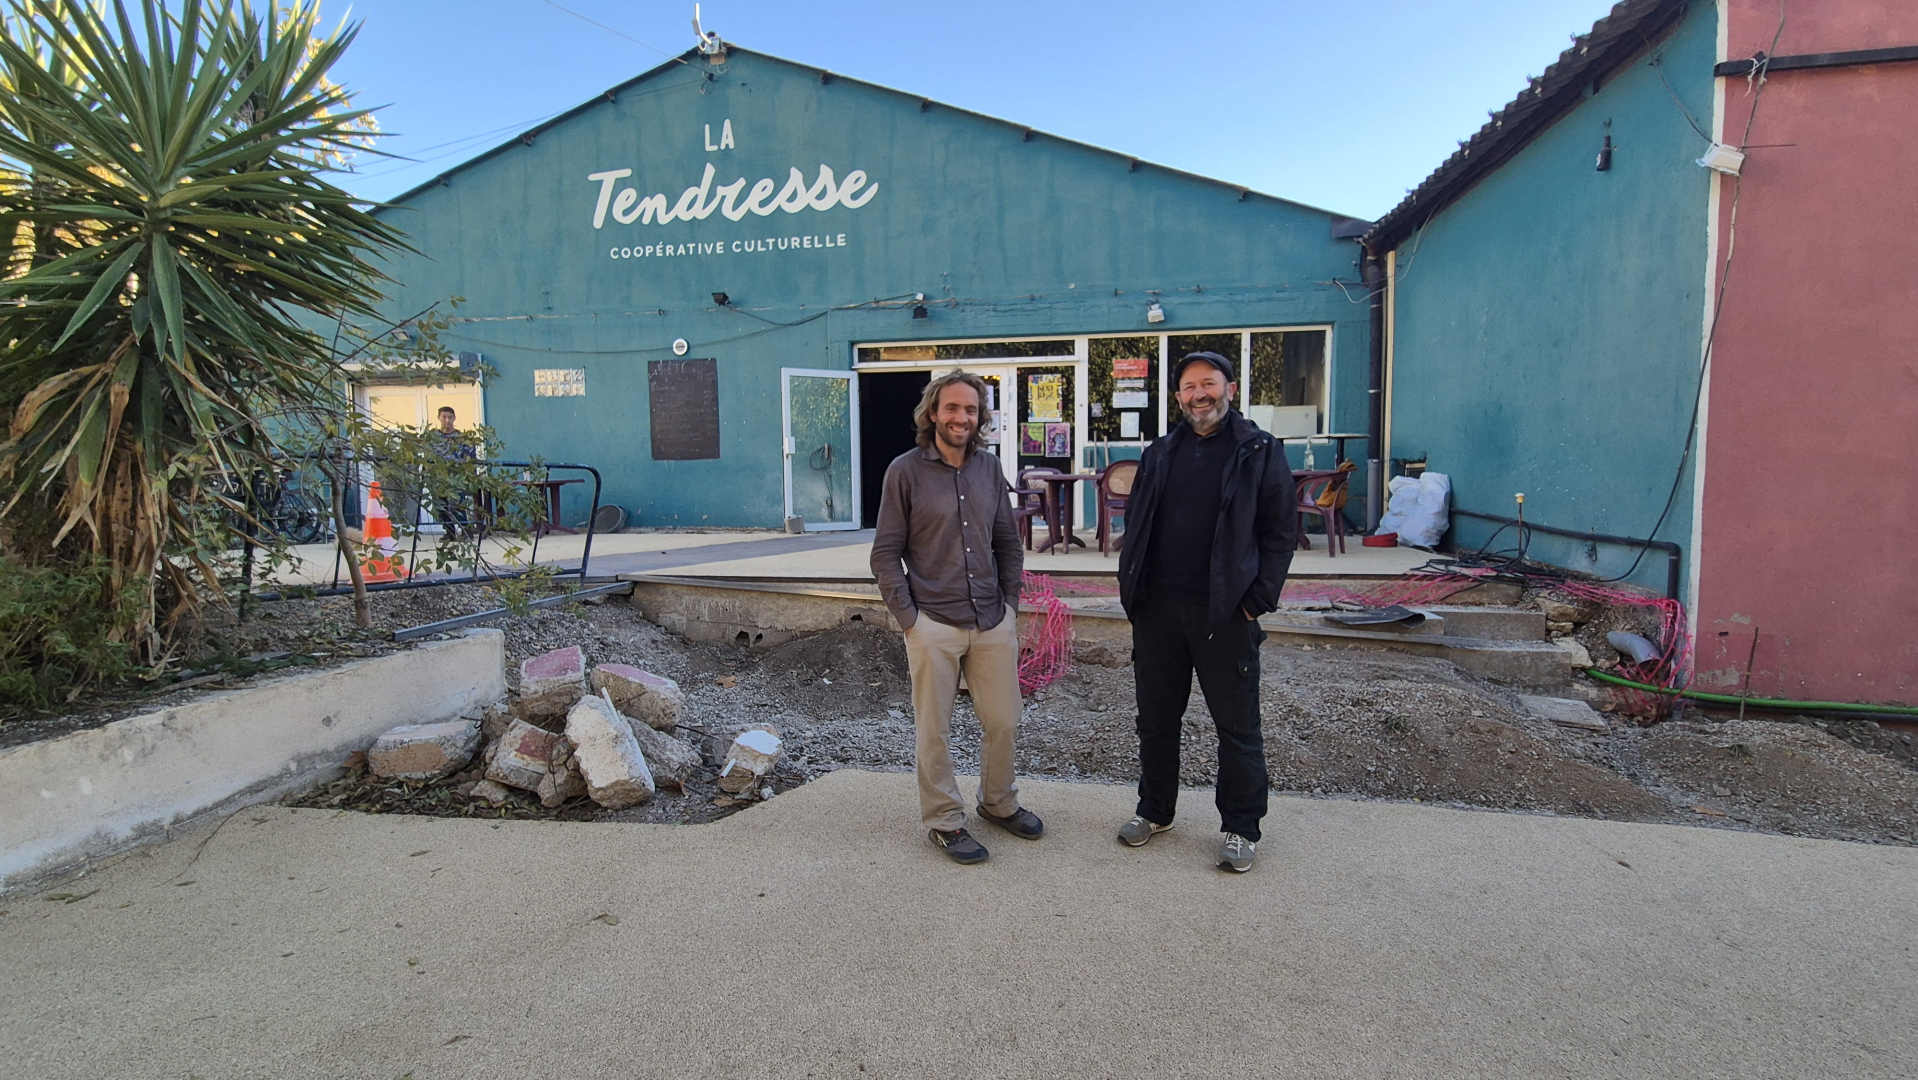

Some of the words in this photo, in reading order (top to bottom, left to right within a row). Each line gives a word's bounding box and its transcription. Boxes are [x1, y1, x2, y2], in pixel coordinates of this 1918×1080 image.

[704, 118, 735, 152] LA
[587, 161, 879, 230] Tendresse
[609, 241, 725, 260] COOPÉRATIVE
[731, 233, 847, 253] CULTURELLE
